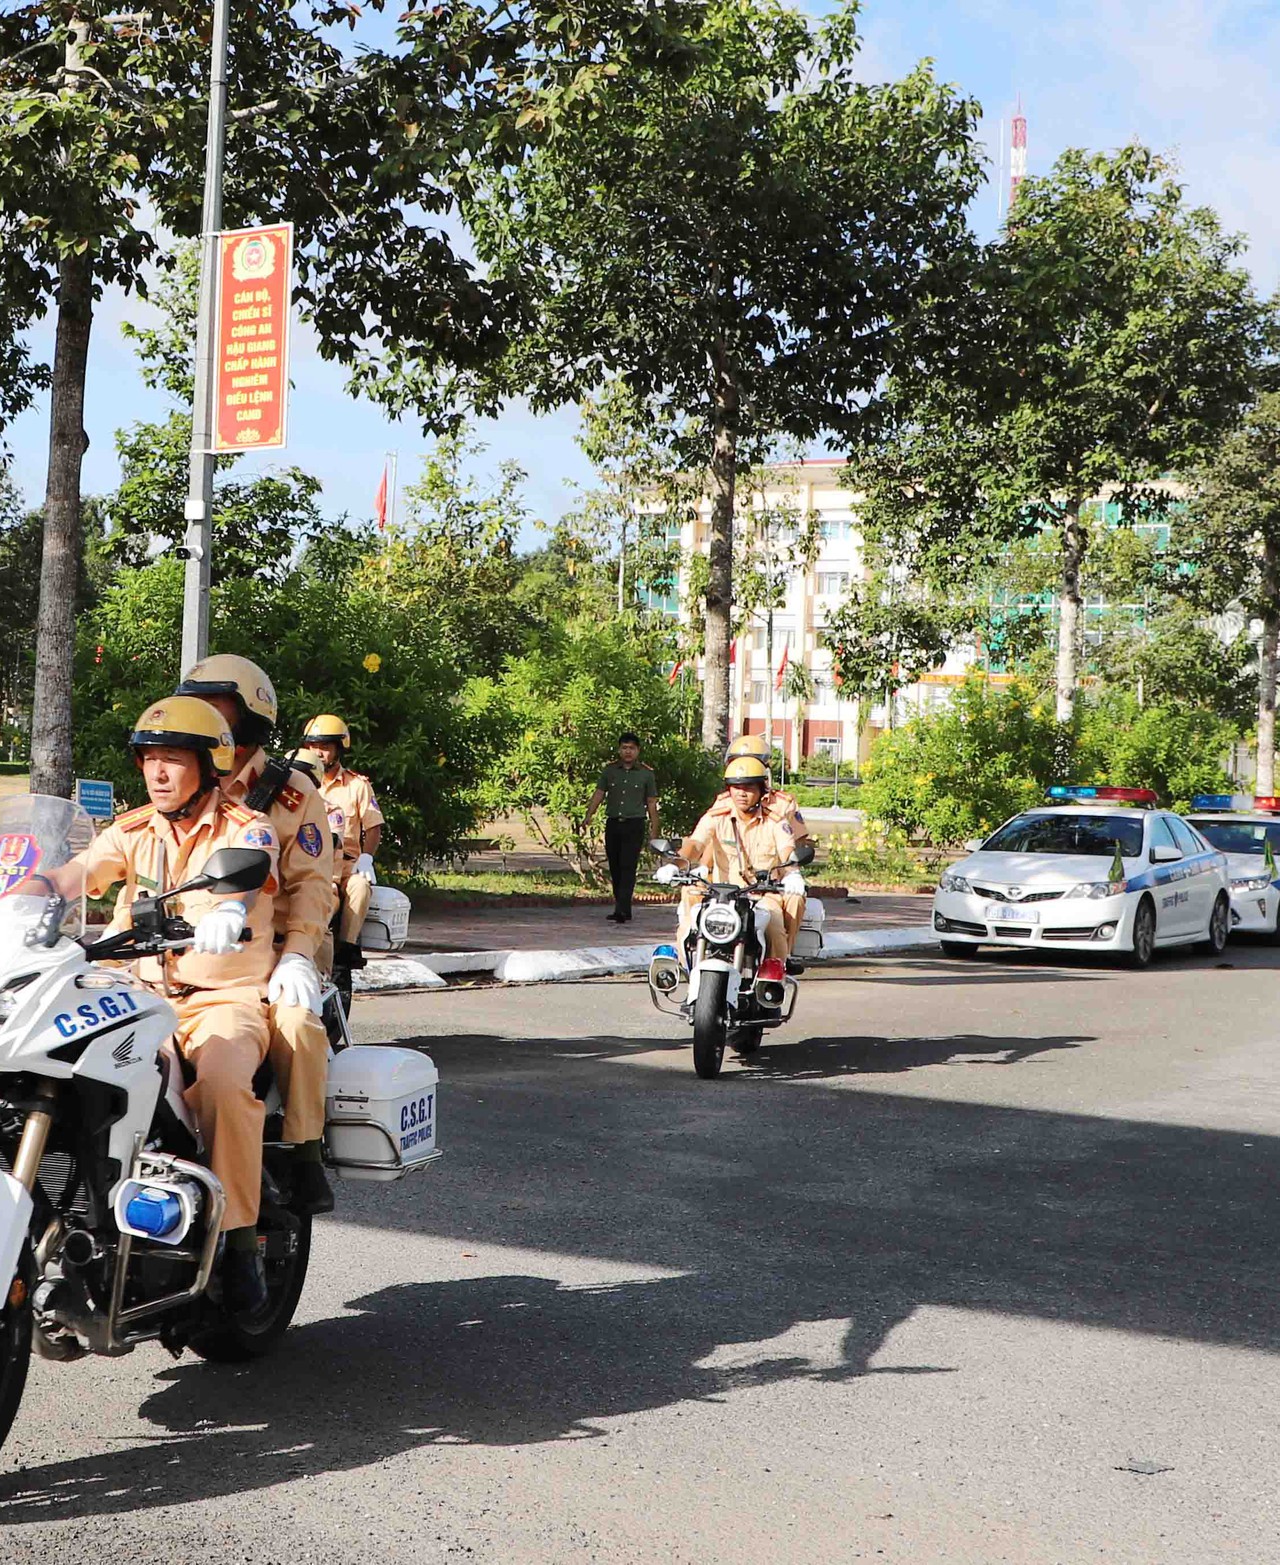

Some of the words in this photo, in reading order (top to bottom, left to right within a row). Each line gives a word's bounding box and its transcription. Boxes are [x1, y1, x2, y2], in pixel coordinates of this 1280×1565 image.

[258, 323, 272, 335] AN
[247, 339, 276, 353] GIANG
[54, 992, 137, 1037] C.S.G.T
[400, 1094, 433, 1132] C.S.G.T
[400, 1130, 417, 1151] TRAFFIC
[418, 1123, 432, 1142] POLICE
